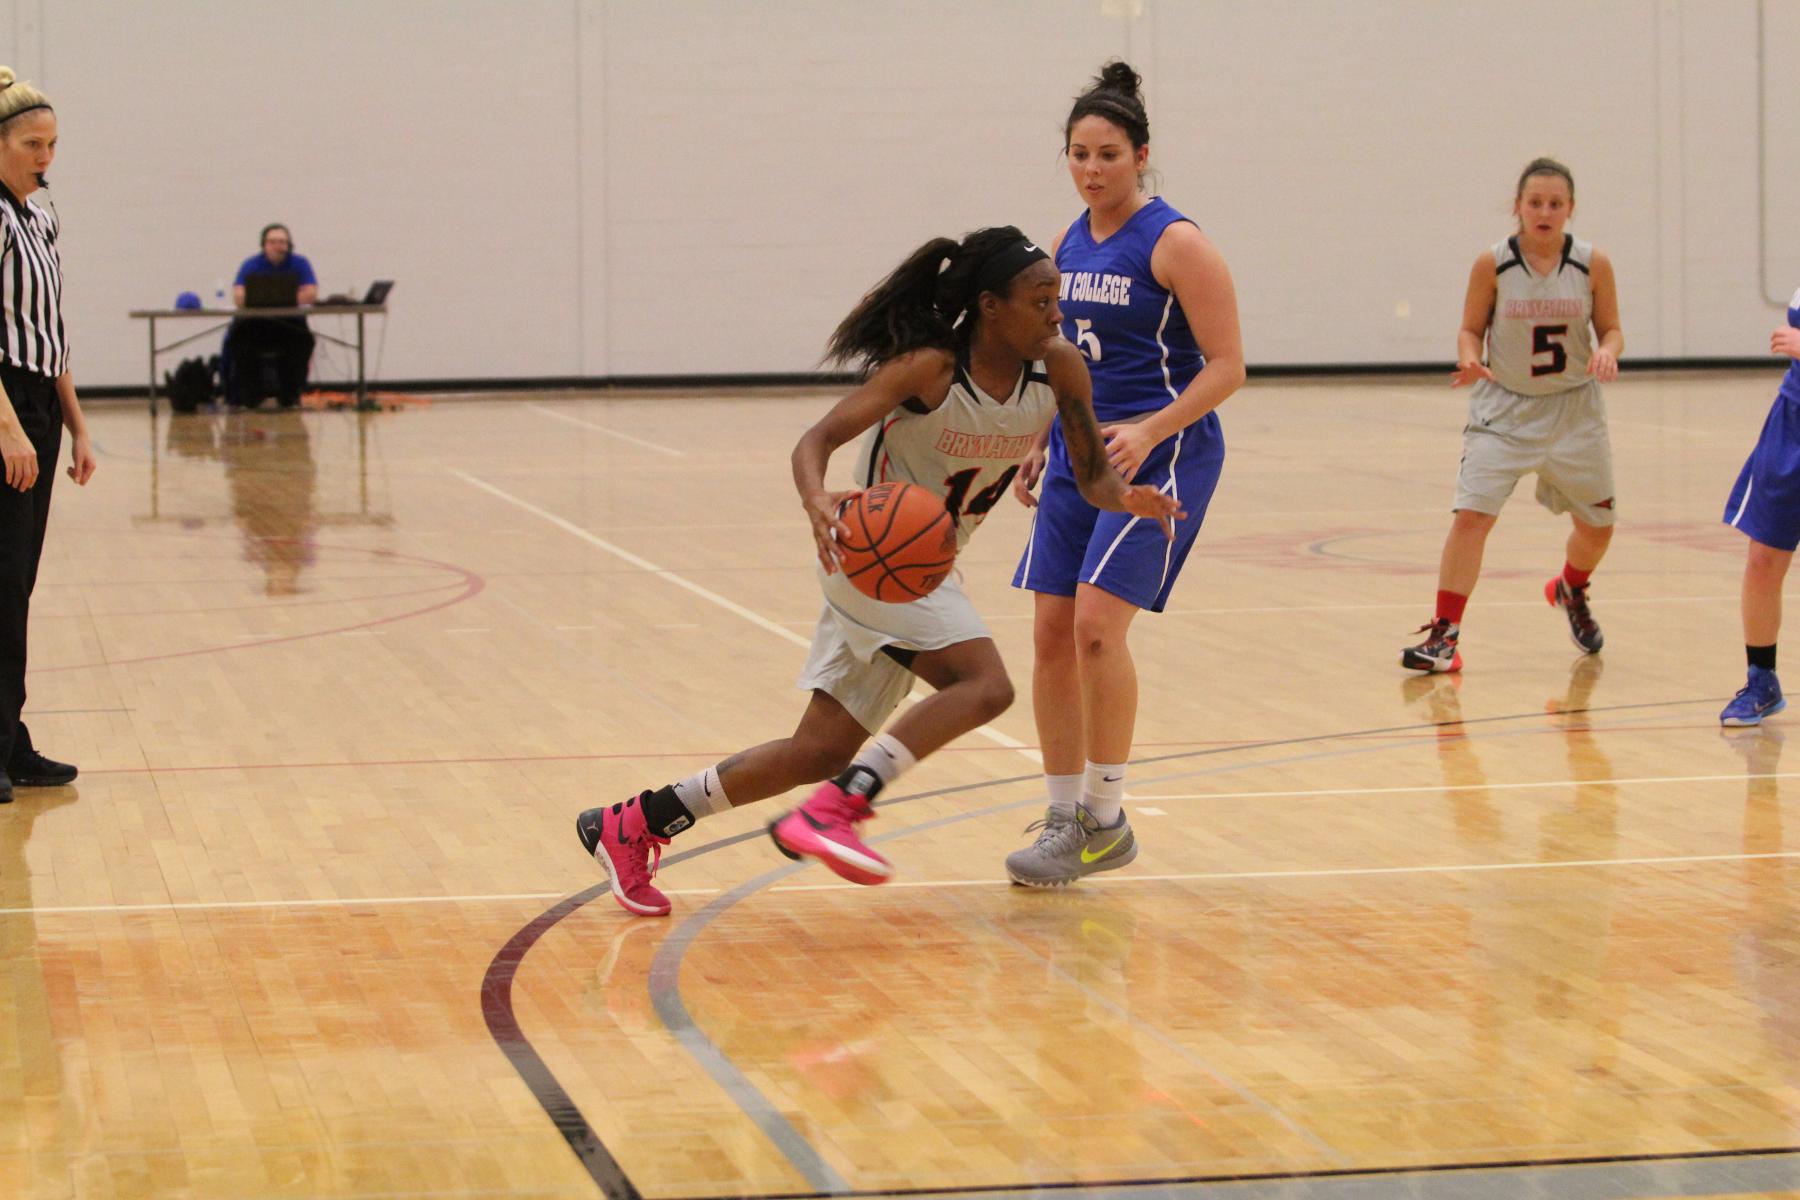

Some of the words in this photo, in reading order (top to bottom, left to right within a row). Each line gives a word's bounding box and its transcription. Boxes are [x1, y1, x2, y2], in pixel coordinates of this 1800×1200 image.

[1071, 271, 1131, 306] COLLEGE
[1531, 324, 1568, 377] 5
[944, 464, 1021, 528] 14
